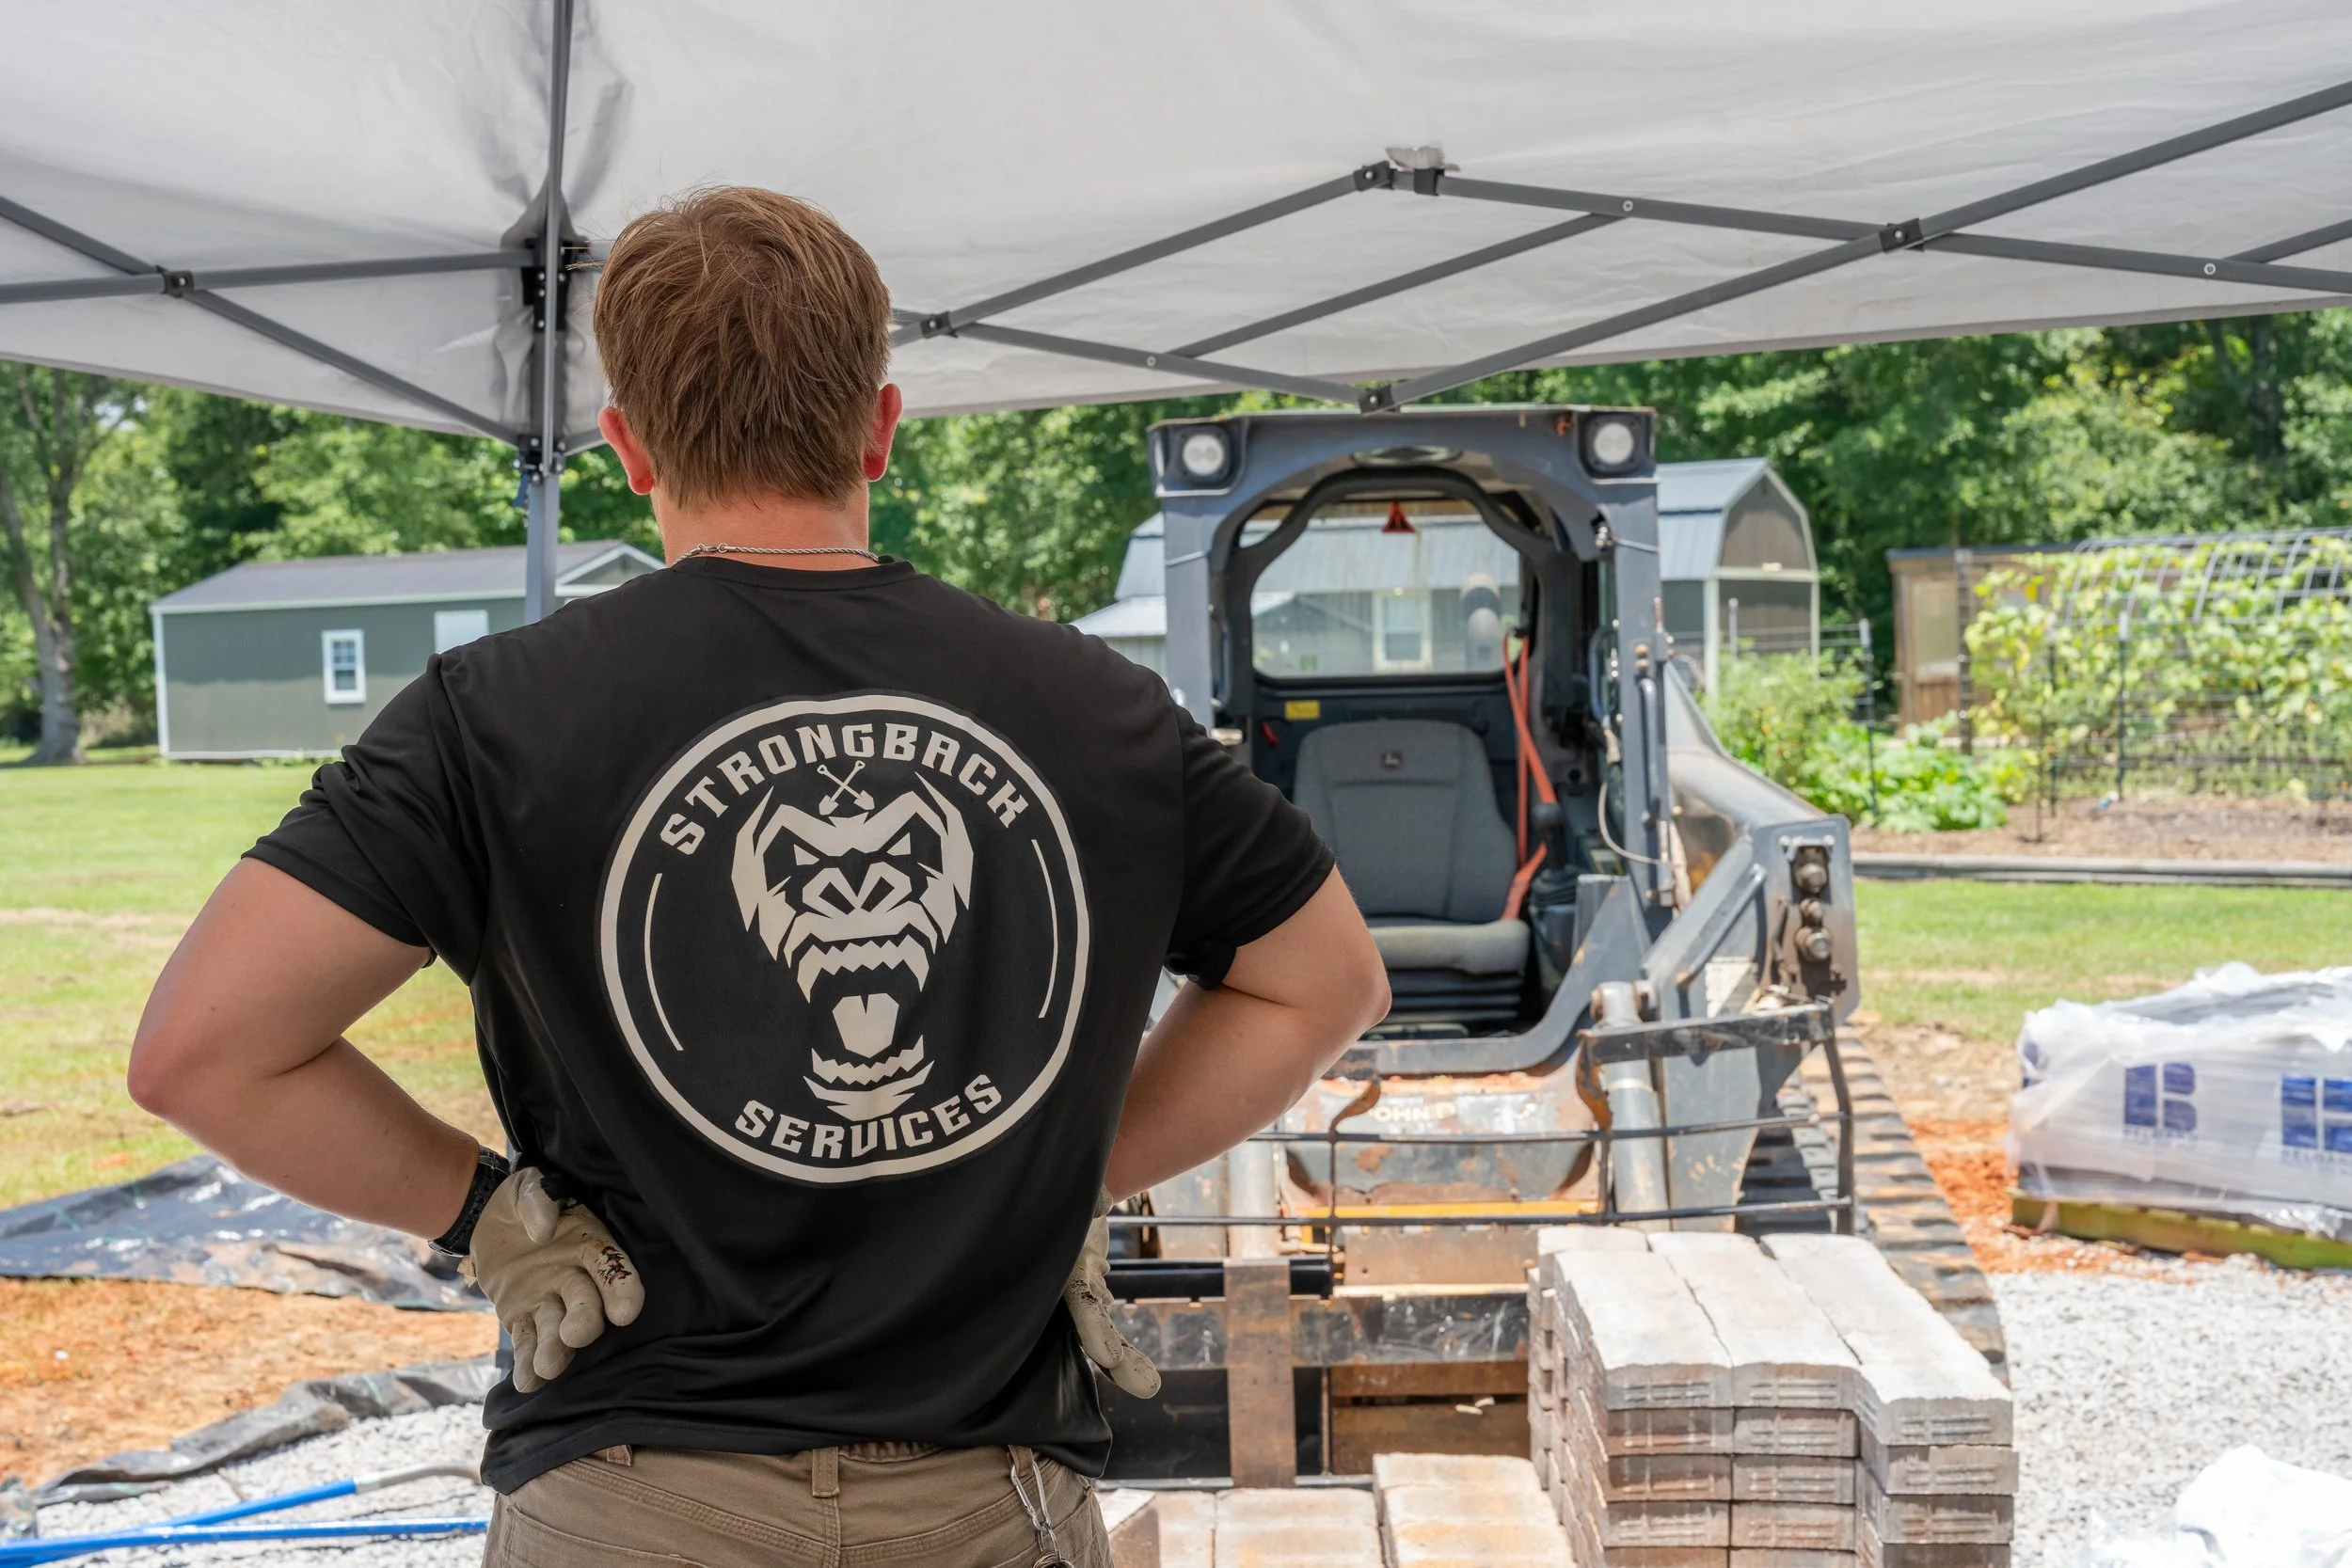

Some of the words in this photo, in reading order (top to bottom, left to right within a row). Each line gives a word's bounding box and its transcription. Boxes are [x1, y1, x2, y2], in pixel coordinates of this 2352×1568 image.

[660, 722, 1029, 855] STRONGBACK
[735, 1074, 1002, 1159] SERVICES
[1368, 1105, 1431, 1123] OHN
